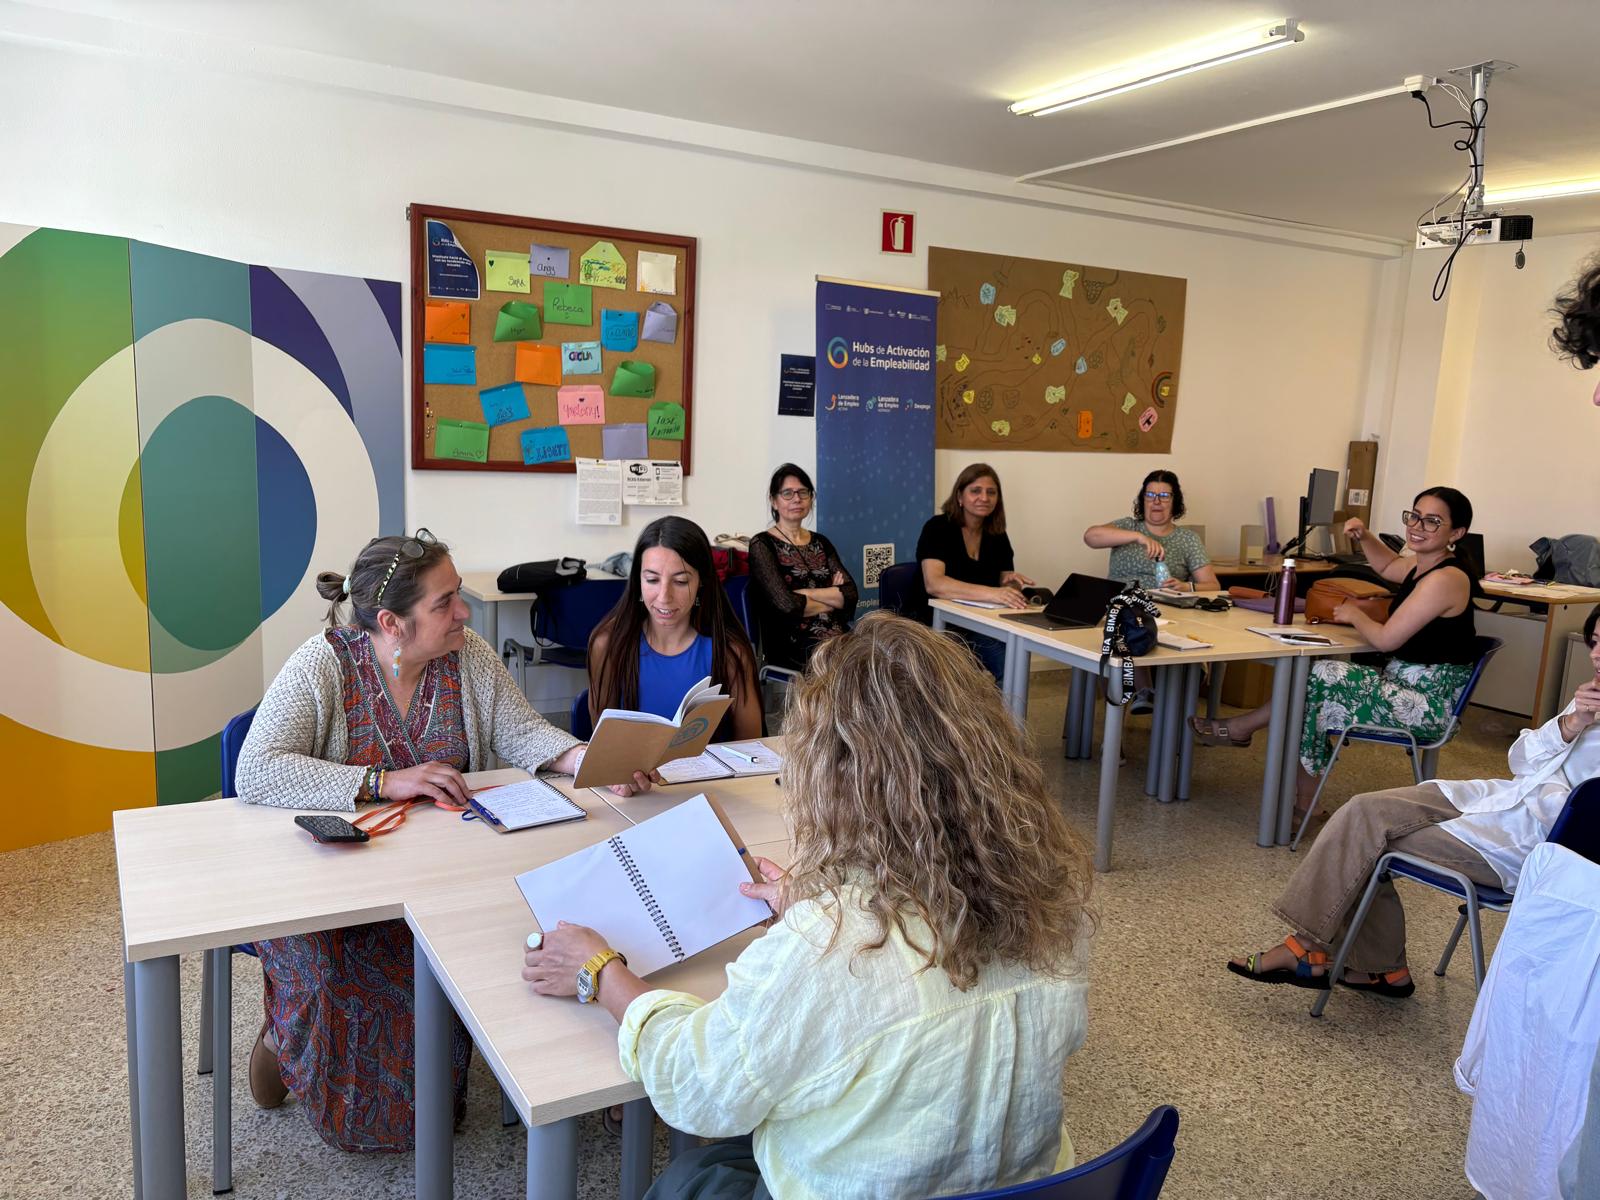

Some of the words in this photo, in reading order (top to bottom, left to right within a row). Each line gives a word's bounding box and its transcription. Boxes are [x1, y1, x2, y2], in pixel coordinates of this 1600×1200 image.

[852, 341, 875, 354] Hubs
[876, 346, 886, 355] de
[886, 345, 930, 358] Activación
[852, 357, 861, 366] de
[862, 358, 869, 367] la
[870, 356, 930, 371] Empleabilidad
